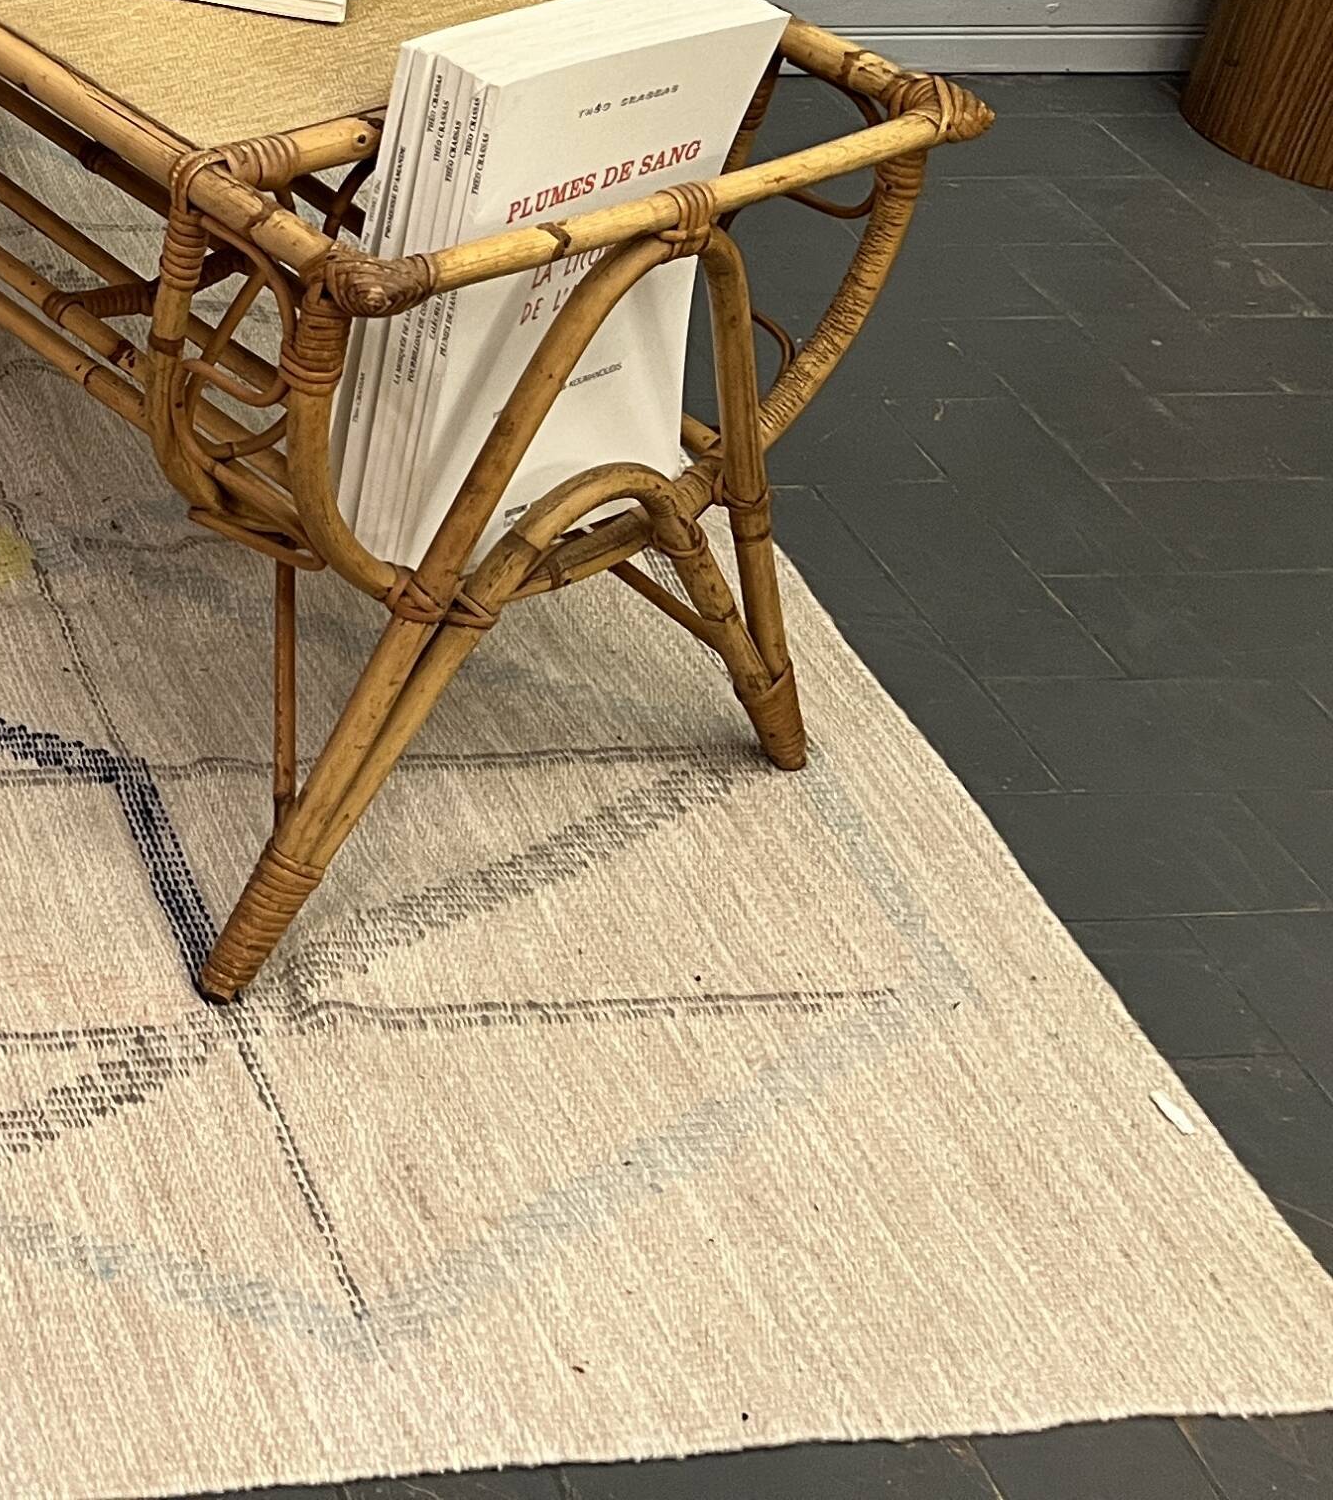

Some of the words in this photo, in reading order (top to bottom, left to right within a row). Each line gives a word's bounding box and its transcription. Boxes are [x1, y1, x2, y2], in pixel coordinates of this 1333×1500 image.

[506, 172, 597, 224] PLUMES
[601, 160, 634, 189] DE
[638, 139, 702, 176] SANG
[520, 296, 545, 326] DE
